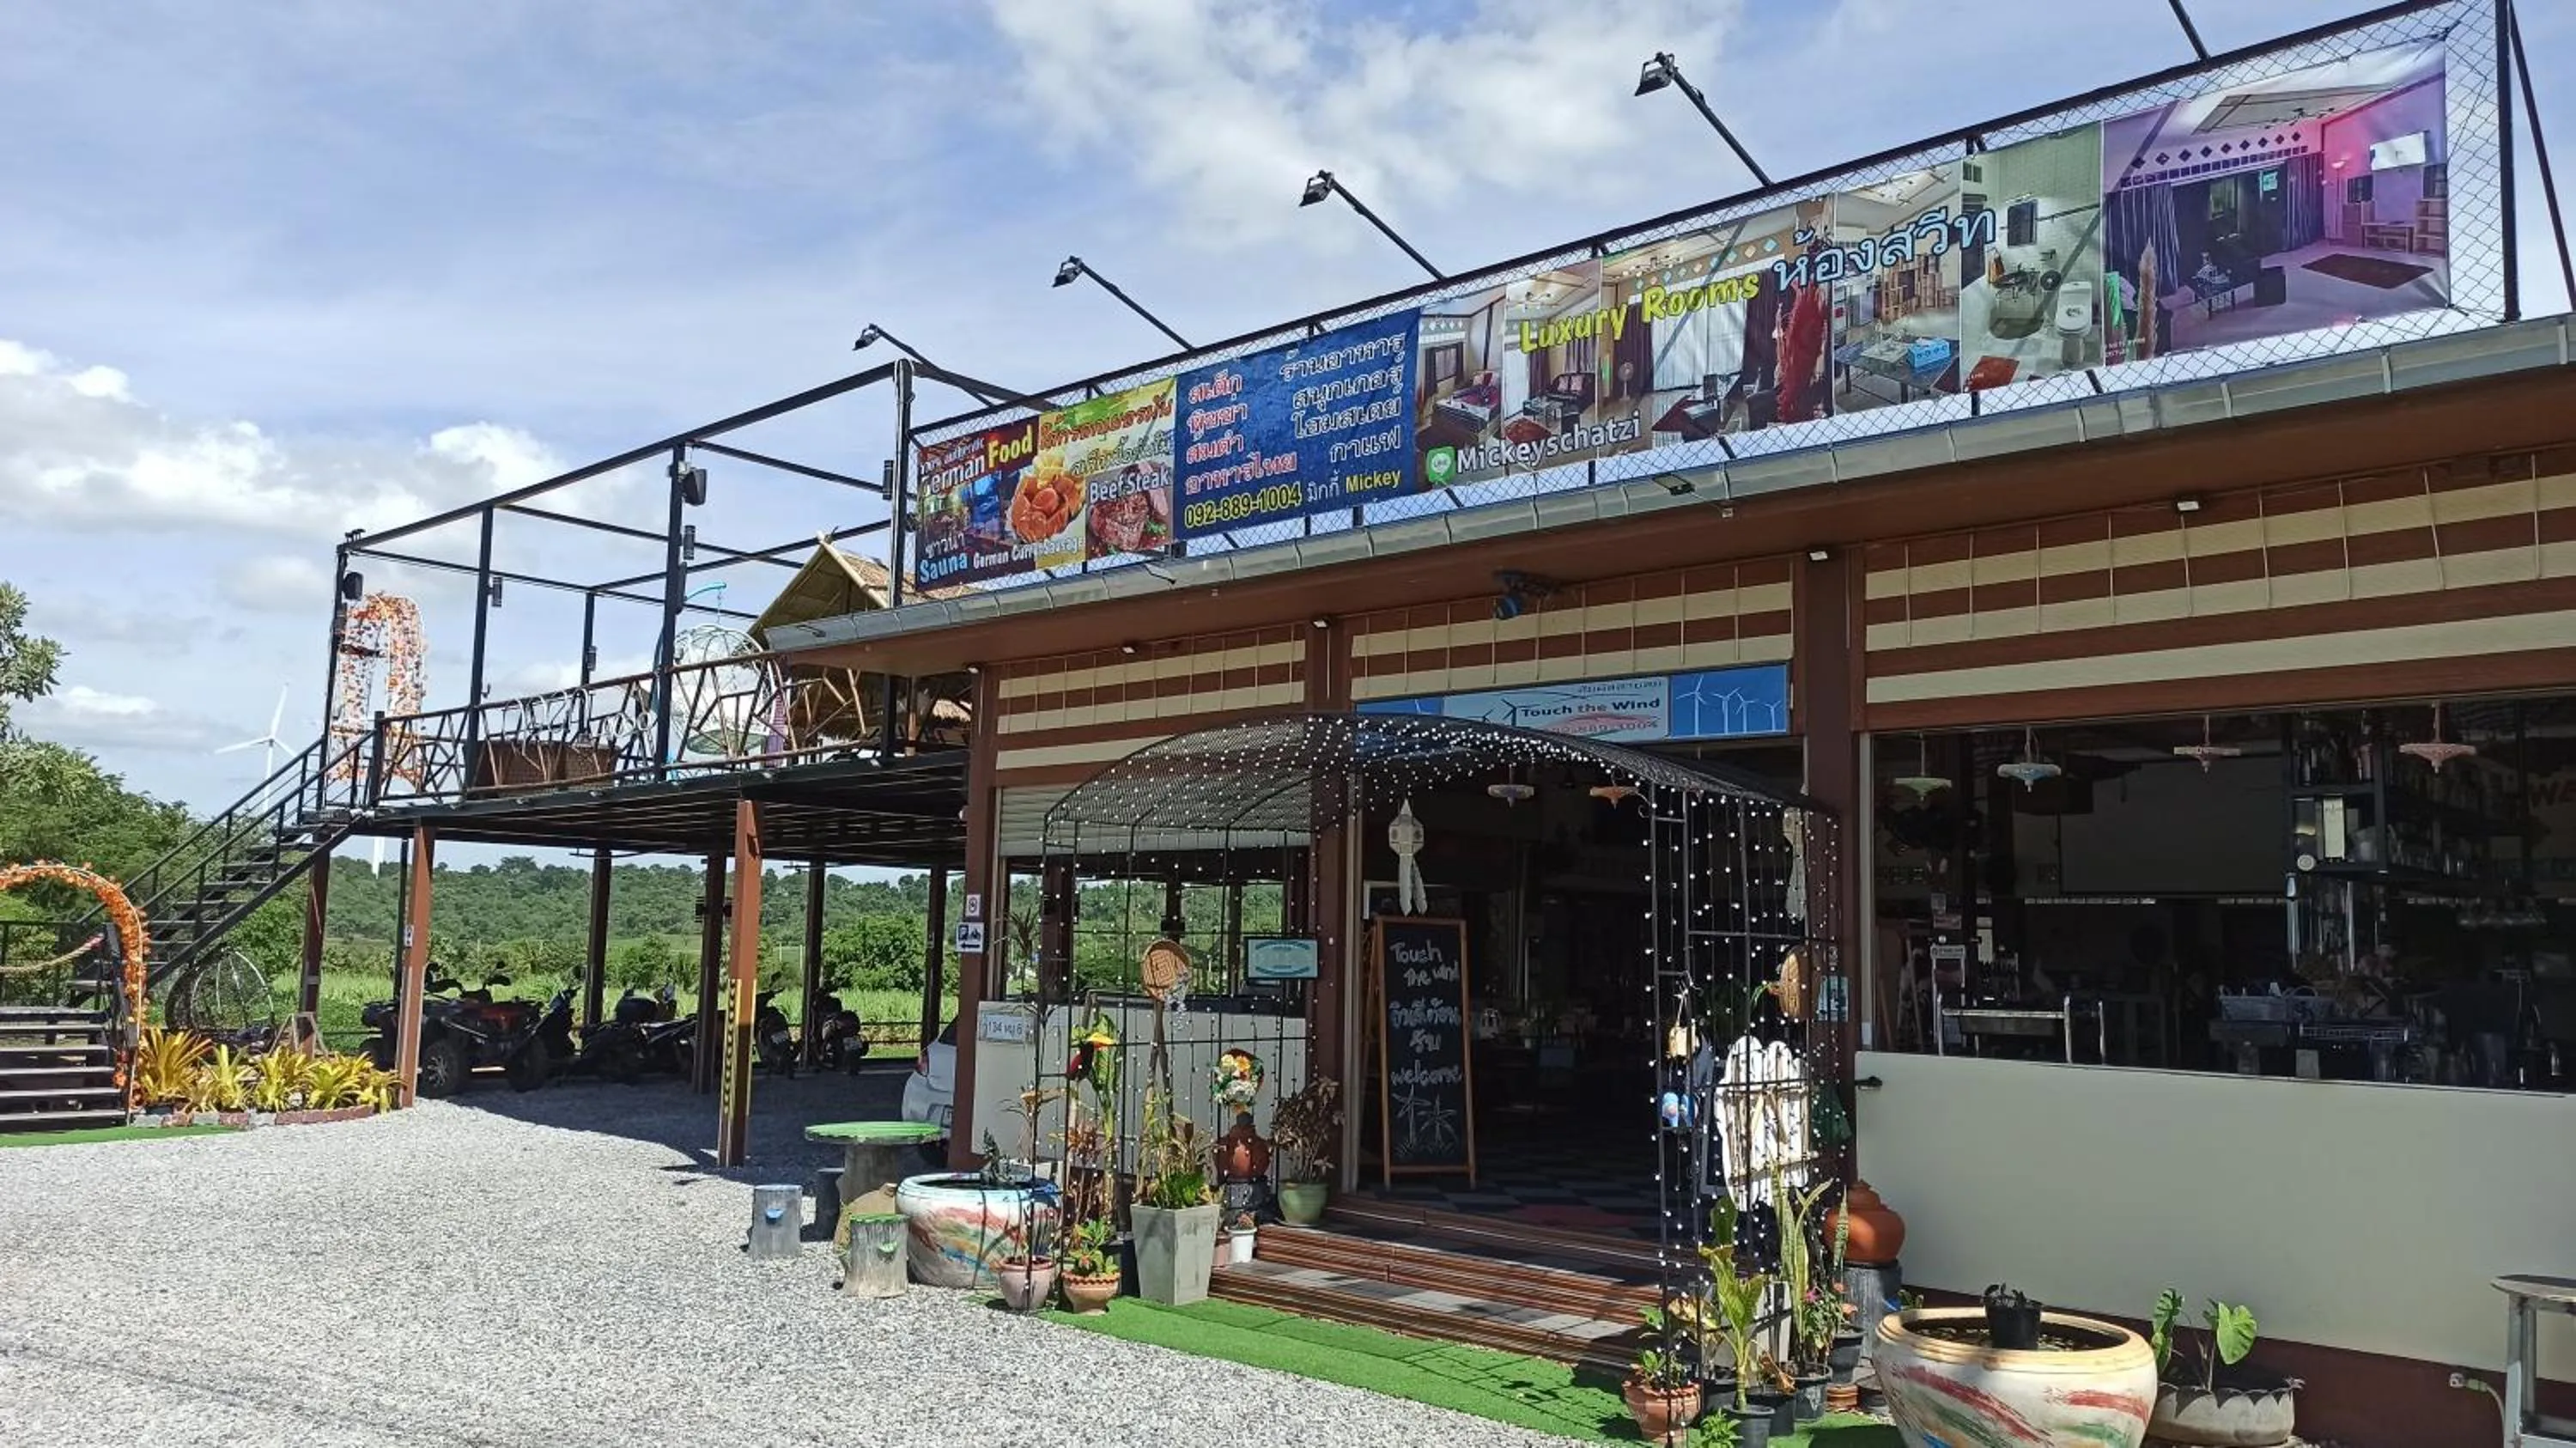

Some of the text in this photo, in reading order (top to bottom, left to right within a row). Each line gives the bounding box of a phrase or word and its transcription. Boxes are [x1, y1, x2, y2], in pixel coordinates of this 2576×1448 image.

[1771, 204, 1997, 293] ห้องสวีท
[1518, 271, 1760, 355] Luxury Rooms
[987, 424, 1034, 469] Food
[1330, 425, 1401, 464] กาแฟ
[1455, 410, 1643, 472] Mickeyschatzi
[1089, 469, 1170, 503] Beef Steak
[1184, 480, 1303, 528] 092-889-1004
[1345, 469, 1401, 494] Mickey
[919, 551, 968, 583] Sauna
[972, 550, 1009, 569] German
[1521, 697, 1662, 718] Touch the Wind
[1389, 939, 1443, 964] Touch
[1389, 1059, 1462, 1086] welcome
